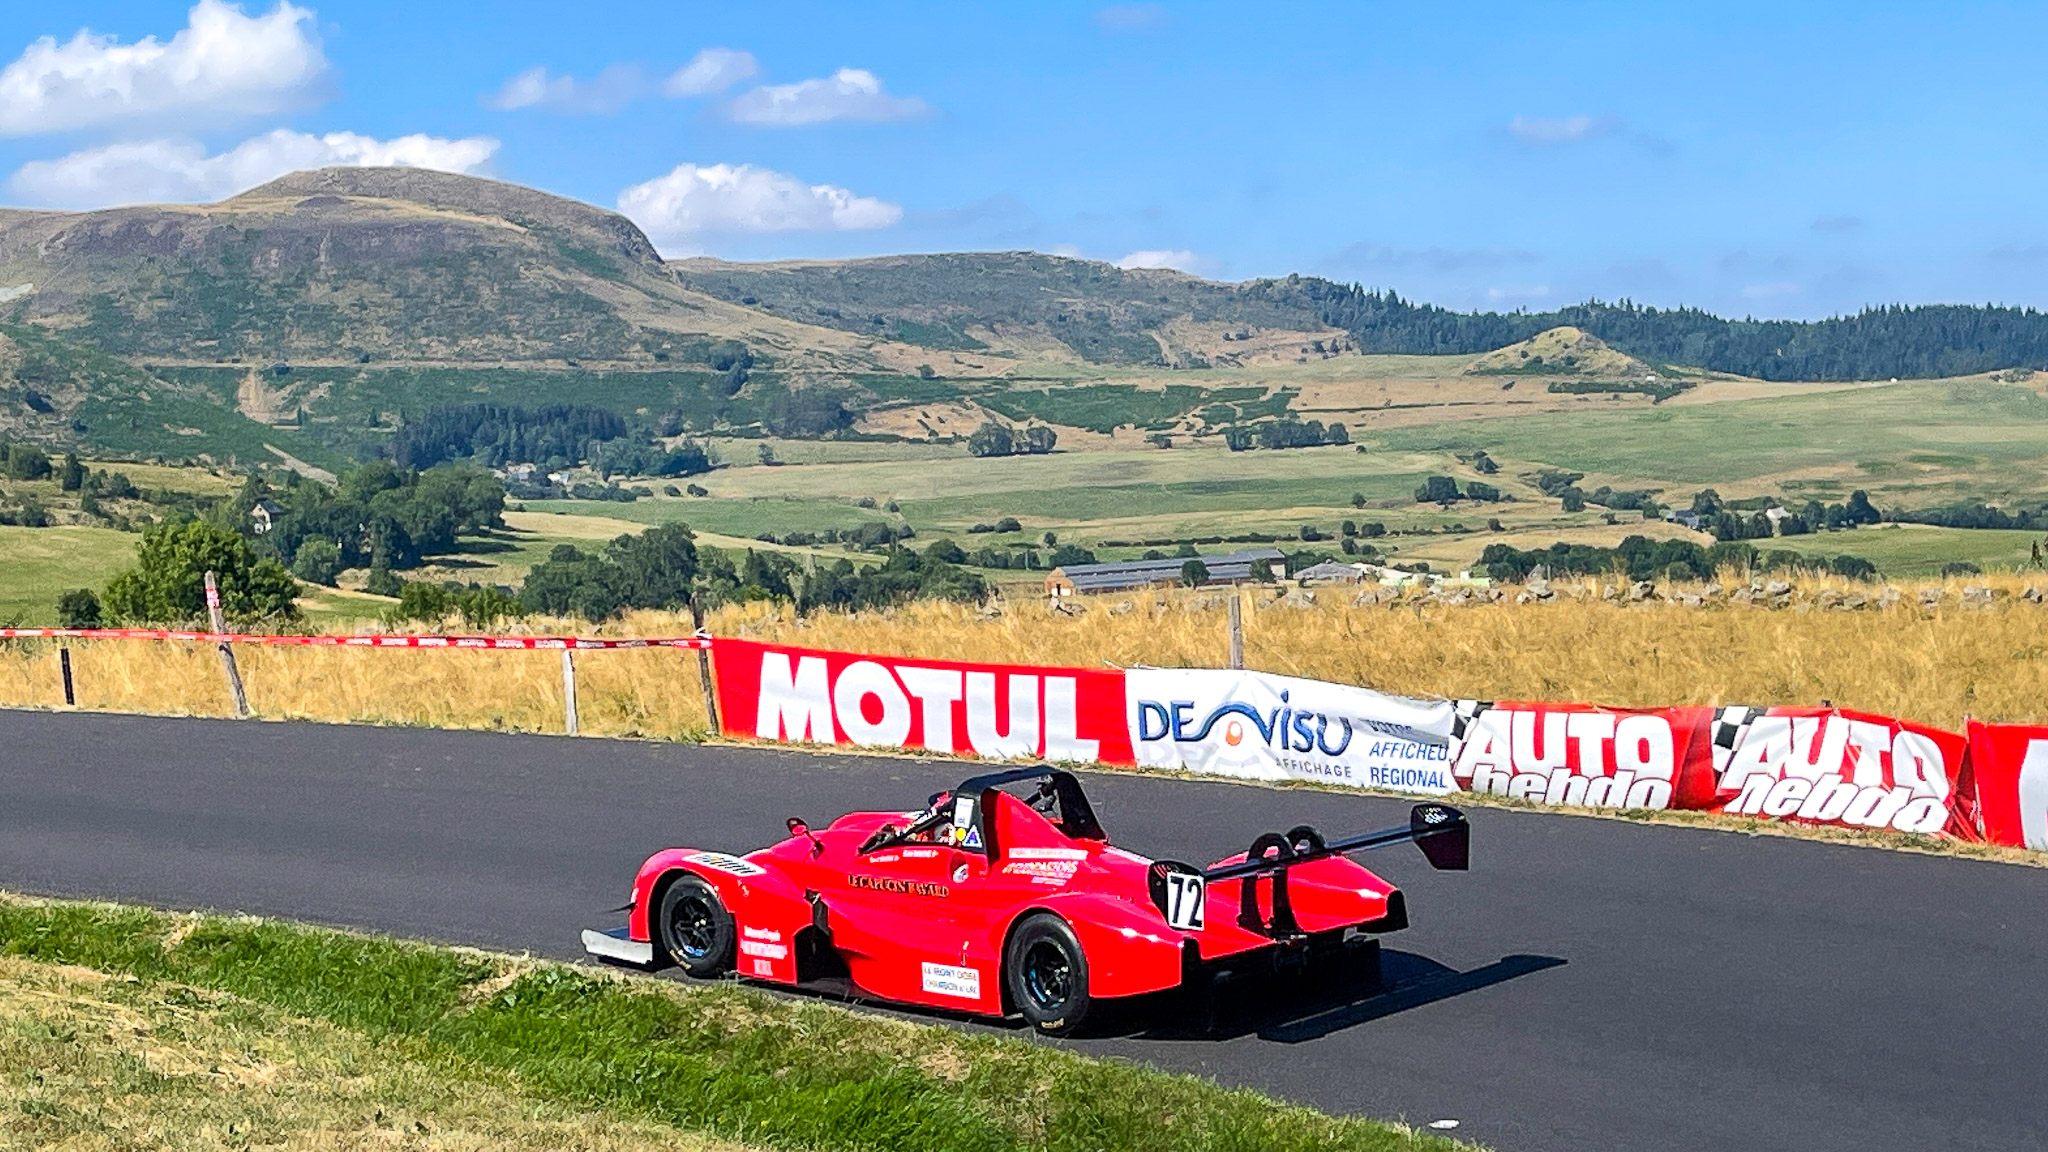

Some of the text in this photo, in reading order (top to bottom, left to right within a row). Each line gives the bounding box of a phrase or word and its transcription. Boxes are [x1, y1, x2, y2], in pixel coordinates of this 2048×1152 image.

[756, 651, 1100, 762] MOTUL
[1275, 758, 1352, 779] AFFICHAGE
[1368, 741, 1448, 761] AFFICHEU
[1455, 710, 1674, 781] AUTO
[1719, 715, 1950, 803] AUTO
[1370, 763, 1448, 788] RÉGIONAL
[1471, 764, 1673, 808] hebdo
[1723, 773, 1950, 833] hebdo
[966, 831, 978, 844] A
[1170, 875, 1202, 927] 72
